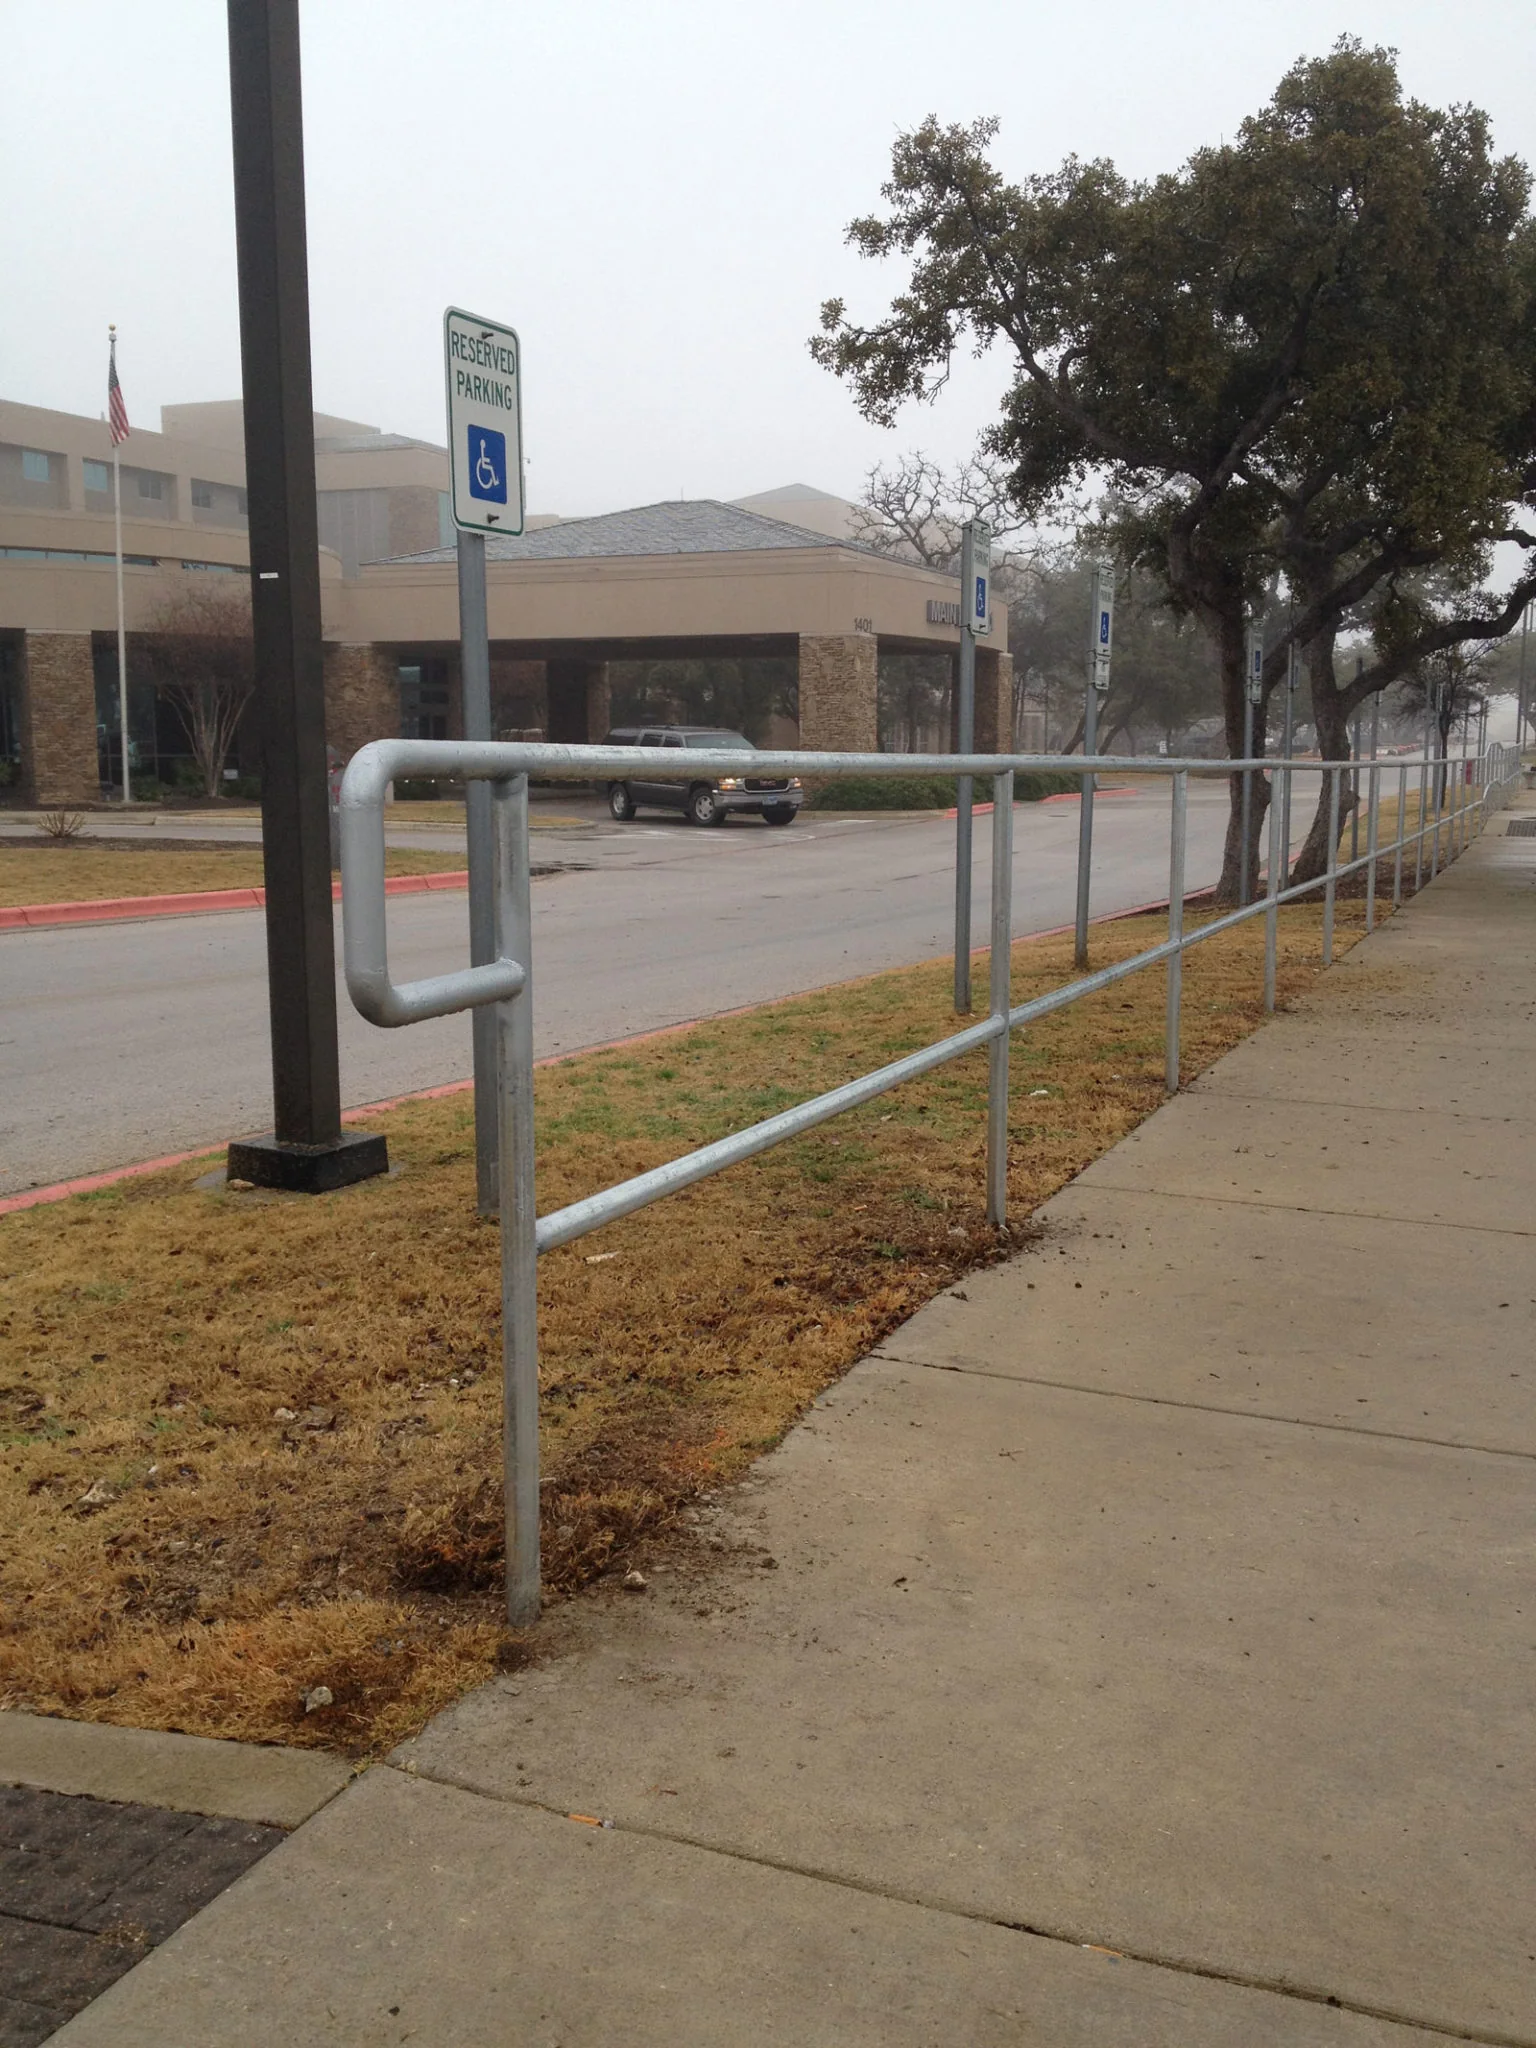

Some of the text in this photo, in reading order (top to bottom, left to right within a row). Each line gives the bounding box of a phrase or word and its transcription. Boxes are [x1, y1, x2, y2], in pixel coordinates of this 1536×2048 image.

[451, 330, 515, 375] RESERVED
[456, 369, 512, 410] PARKING
[854, 617, 873, 633] 1401
[927, 600, 957, 625] MAIN
